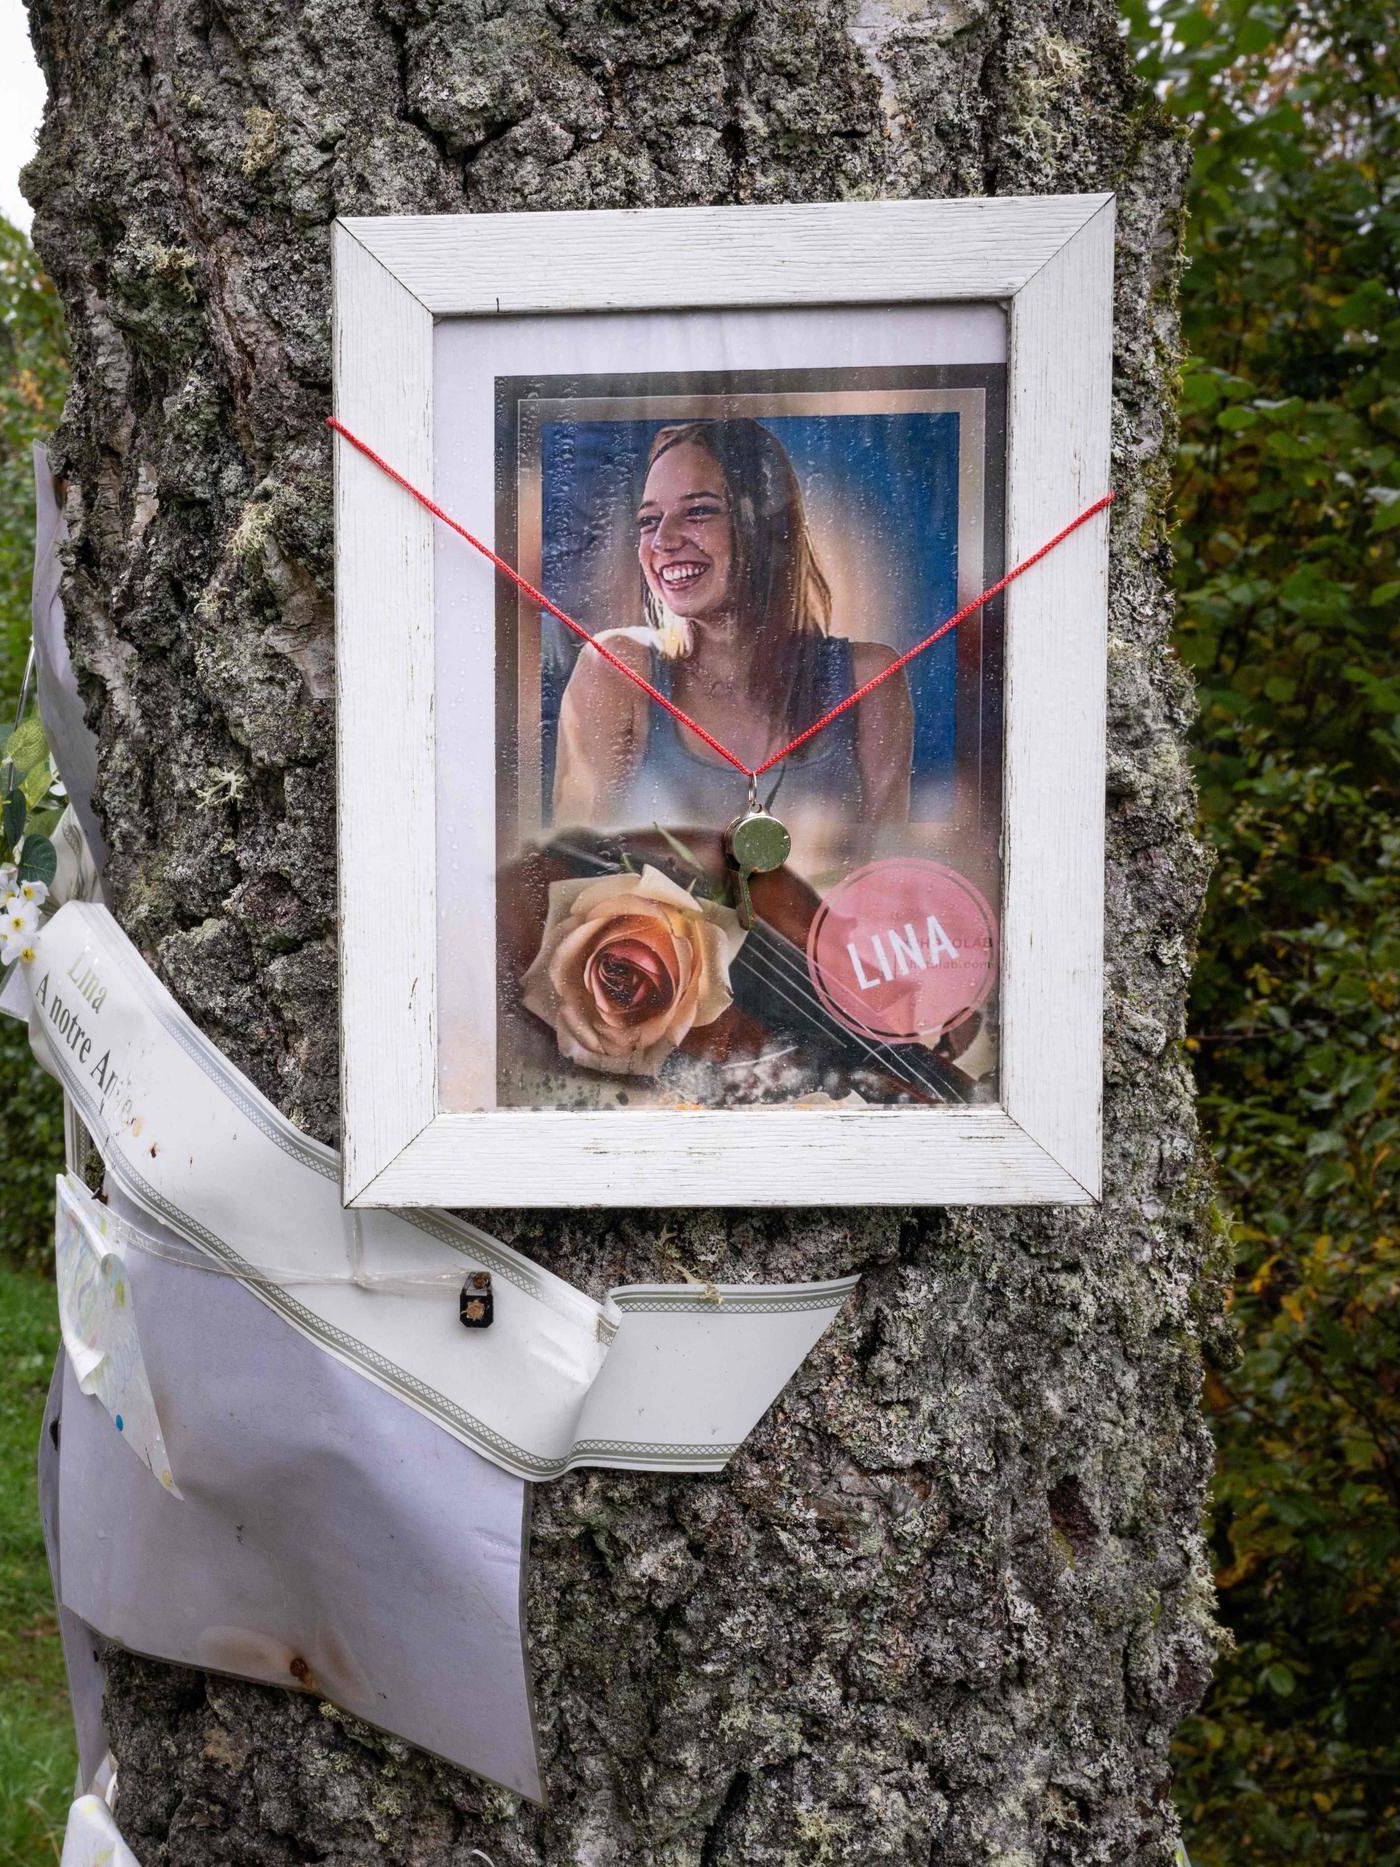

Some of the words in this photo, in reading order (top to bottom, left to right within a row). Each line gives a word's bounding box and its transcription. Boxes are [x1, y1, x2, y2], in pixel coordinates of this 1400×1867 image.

[67, 955, 108, 1014] Lina
[847, 915, 960, 990] LINA
[35, 968, 51, 1008] A
[49, 994, 93, 1064] notre
